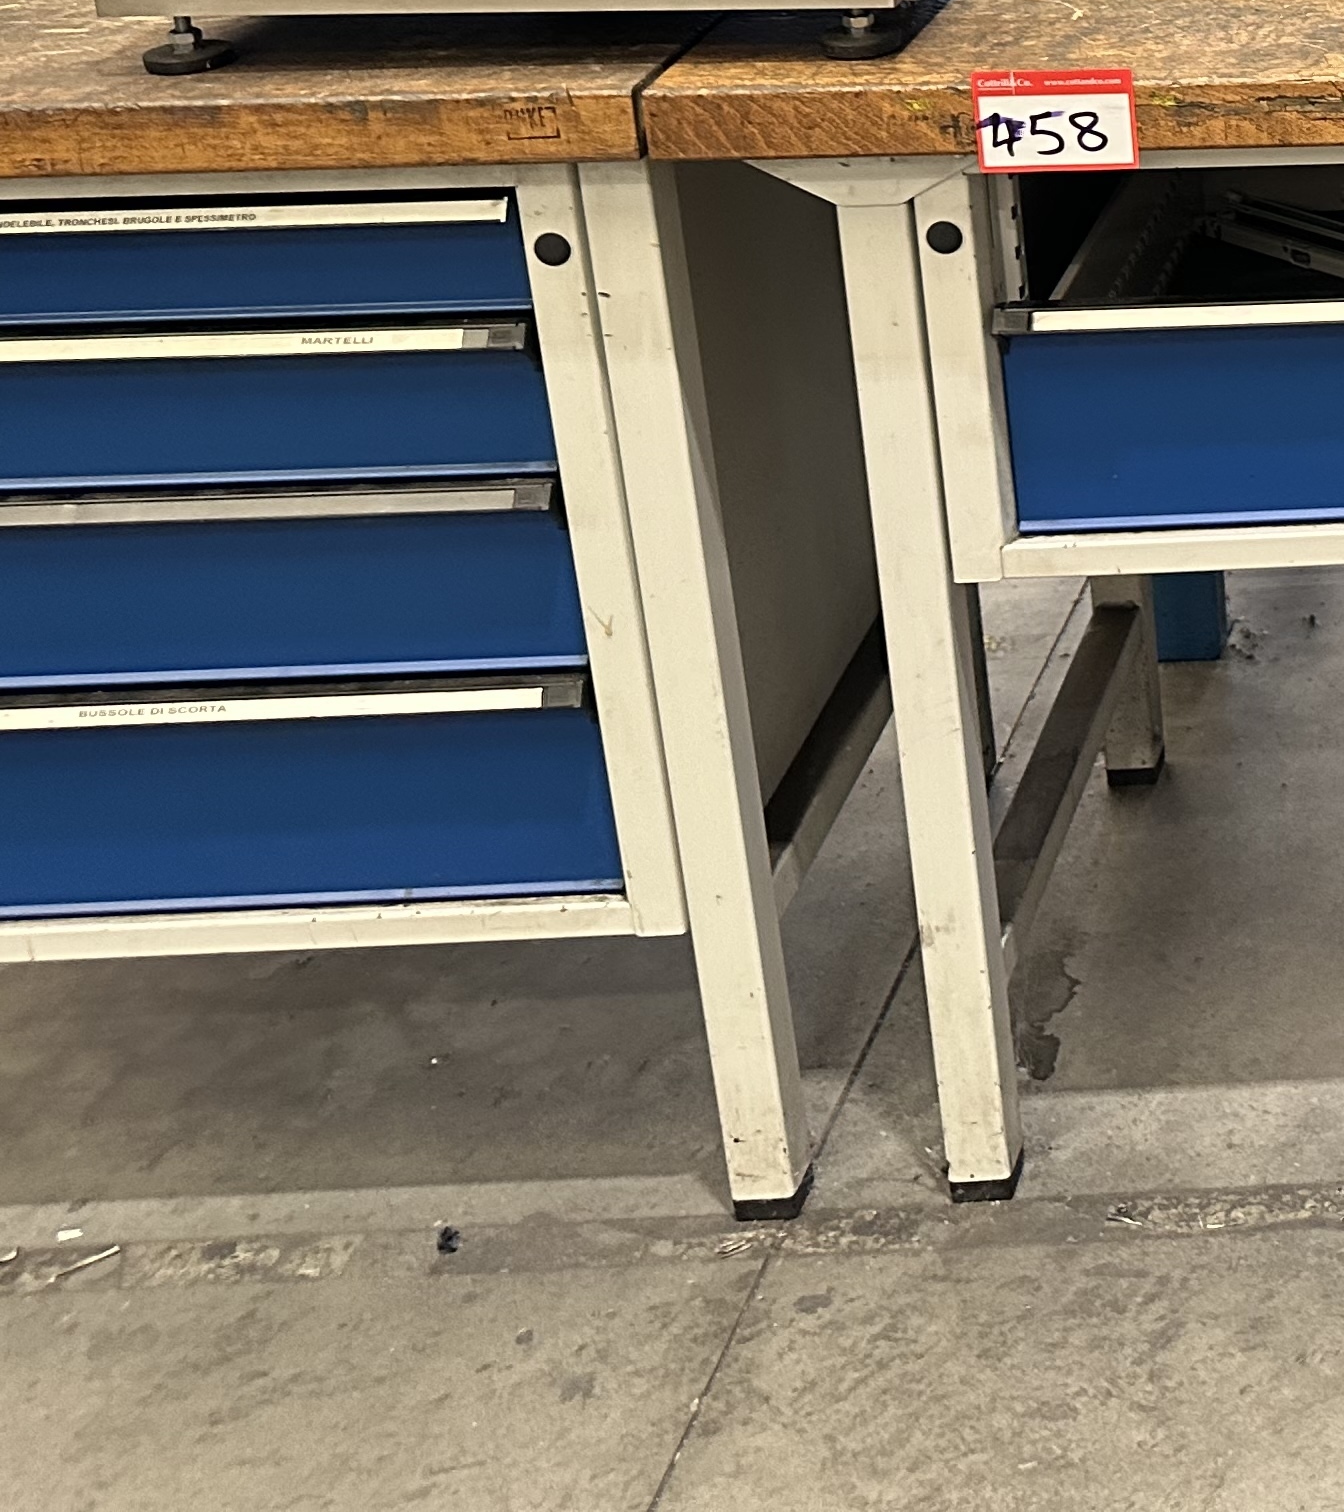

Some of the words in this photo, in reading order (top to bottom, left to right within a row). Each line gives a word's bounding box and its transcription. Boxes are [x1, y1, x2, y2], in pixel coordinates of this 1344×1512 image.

[980, 110, 1109, 157] 458
[122, 215, 173, 225] BRUGOLE
[174, 215, 183, 223] E
[184, 213, 257, 223] SPESSIMETRO
[301, 336, 374, 345] MARTELLI
[78, 708, 145, 718] BUSSOLE
[150, 707, 164, 715] DI
[168, 705, 227, 715] SCORTA
